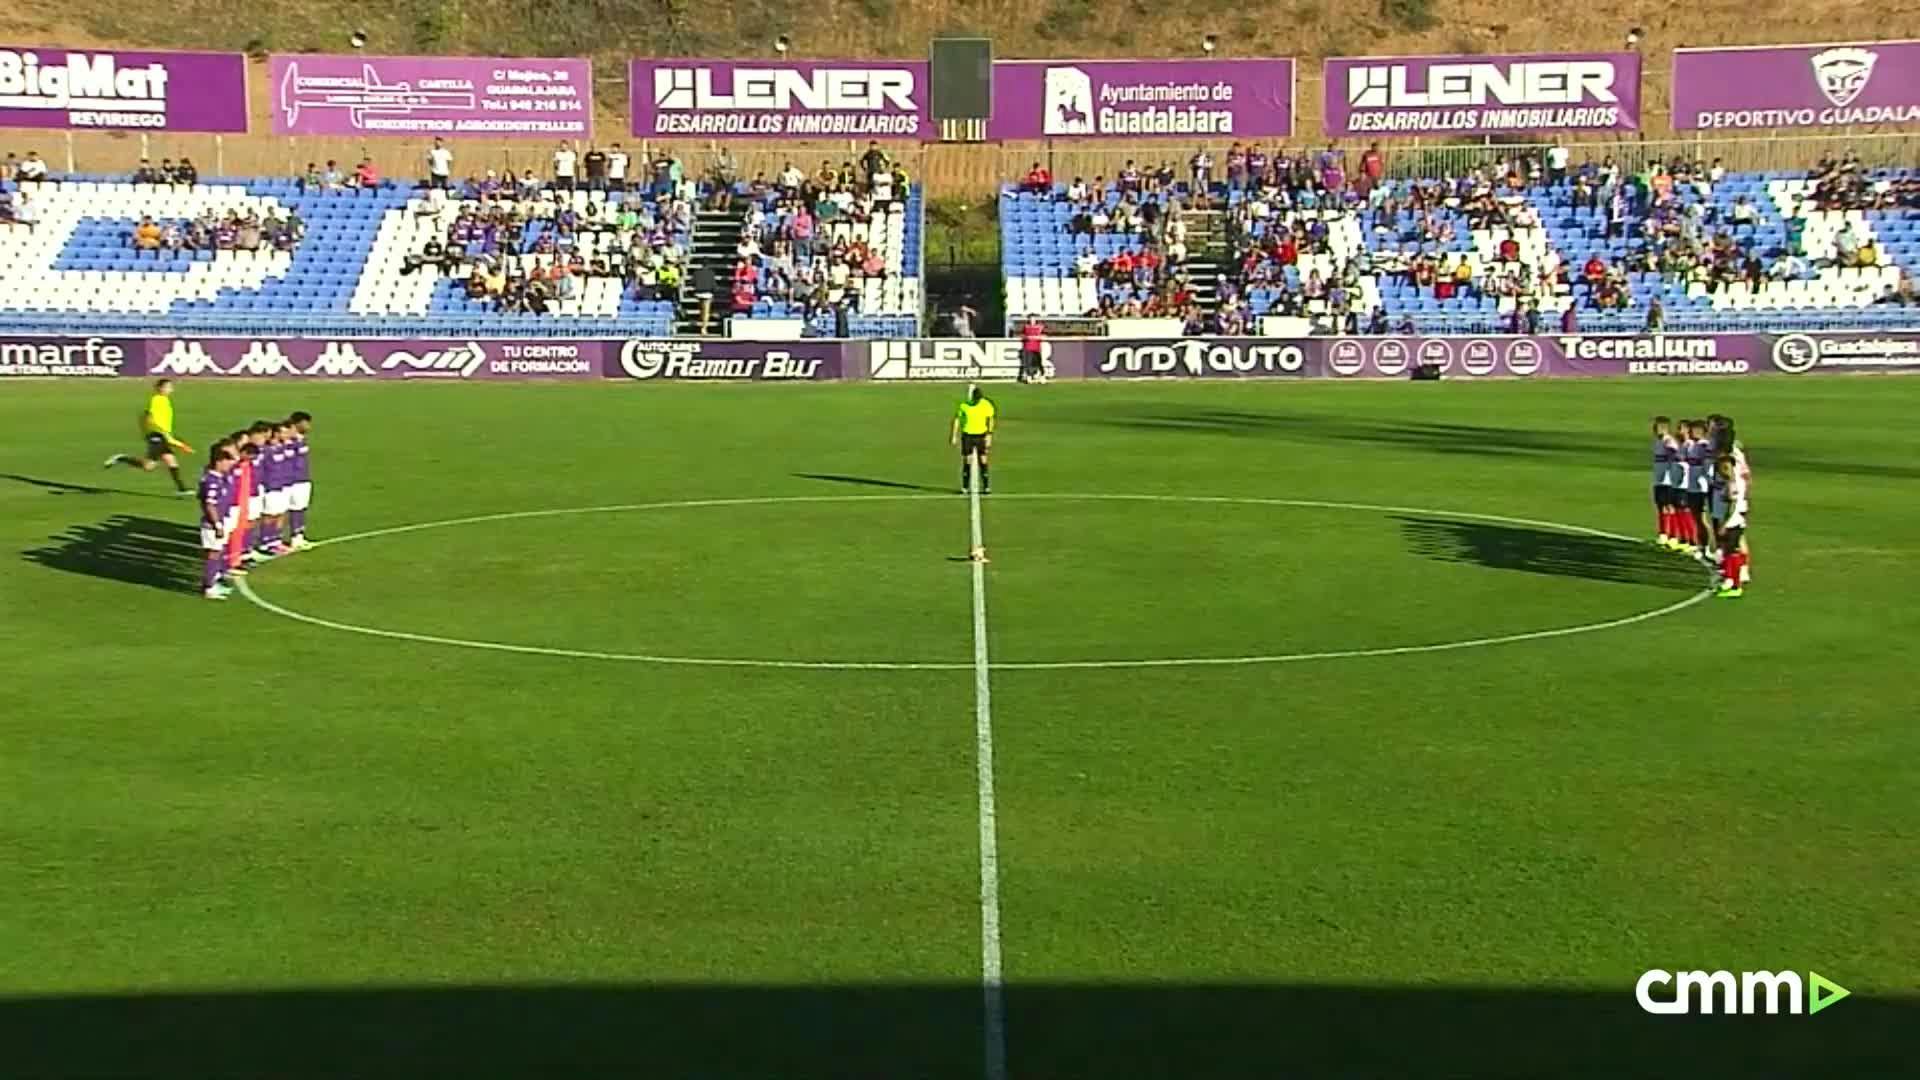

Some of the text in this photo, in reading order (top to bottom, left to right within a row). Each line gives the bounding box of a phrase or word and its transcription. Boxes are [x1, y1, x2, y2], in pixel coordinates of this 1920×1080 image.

[0, 52, 168, 107] BigMat
[695, 68, 918, 109] LENER
[1392, 62, 1618, 105] LENER
[1100, 82, 1232, 106] Ayuntamiento de
[654, 114, 919, 134] DESARROLLOS INMOBILIARIOS
[1100, 106, 1233, 133] Guadalajara
[1348, 107, 1618, 131] DESARROLLOS INMOBILIARIOS
[1697, 109, 1814, 128] DEPORTIVO
[0, 338, 124, 366] marfe
[502, 346, 578, 358] TU CENTRO
[1560, 336, 1716, 359] Tecnalum
[490, 361, 508, 373] DE
[1629, 360, 1749, 373] ELECTRICIDAD
